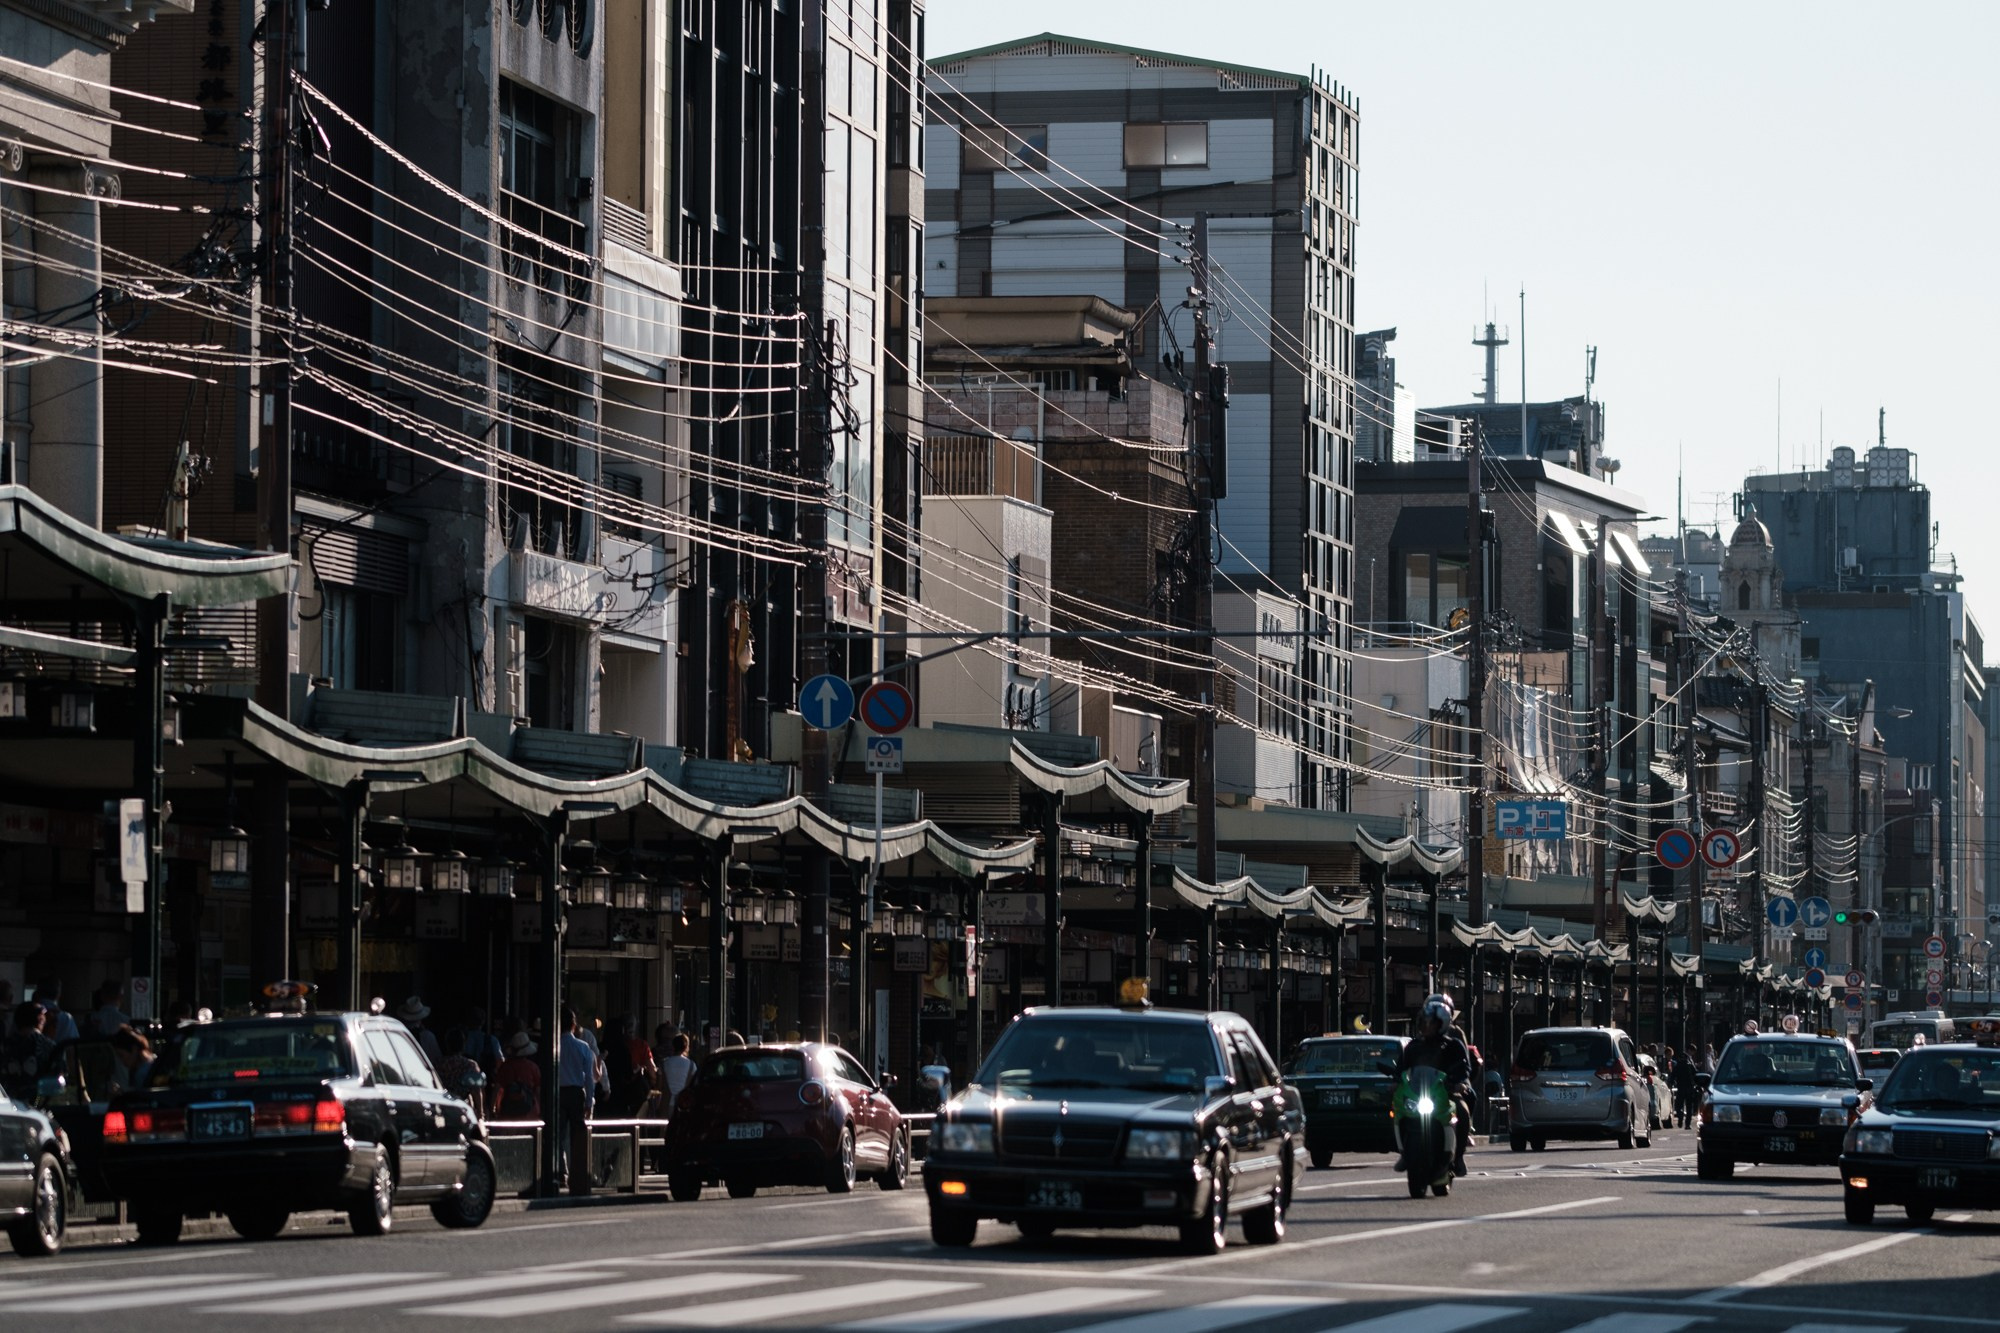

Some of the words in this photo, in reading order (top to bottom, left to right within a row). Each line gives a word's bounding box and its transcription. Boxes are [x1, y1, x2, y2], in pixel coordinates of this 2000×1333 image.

[1498, 808, 1520, 831] P
[206, 1120, 245, 1136] 45-43
[1769, 1141, 1795, 1152] 29-20
[1927, 1175, 1957, 1187] 11-47
